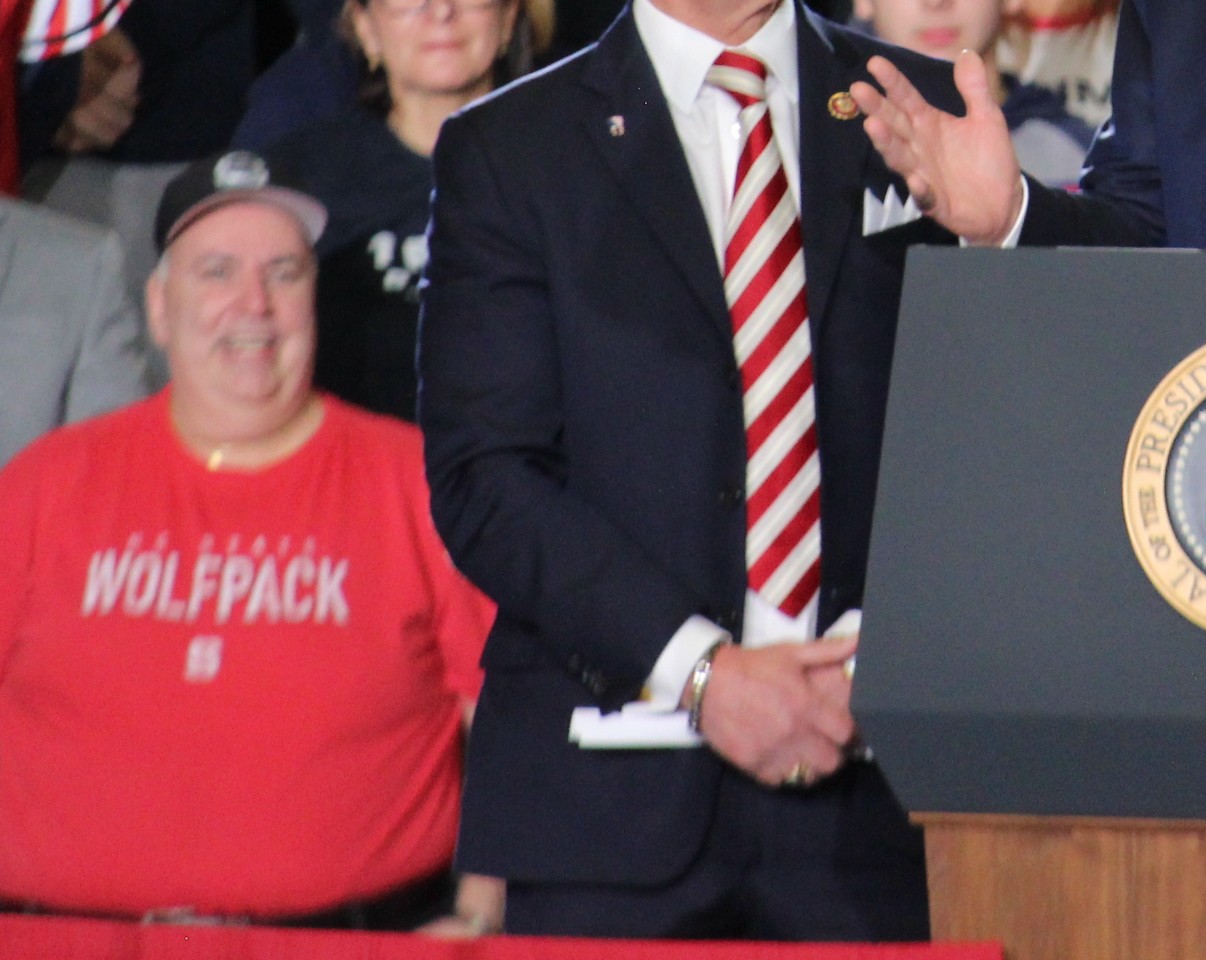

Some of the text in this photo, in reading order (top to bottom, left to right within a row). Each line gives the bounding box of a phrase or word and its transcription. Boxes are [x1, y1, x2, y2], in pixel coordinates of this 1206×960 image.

[1138, 487, 1159, 529] THE
[1148, 535, 1172, 562] OF
[81, 547, 351, 628] WOLFPACK
